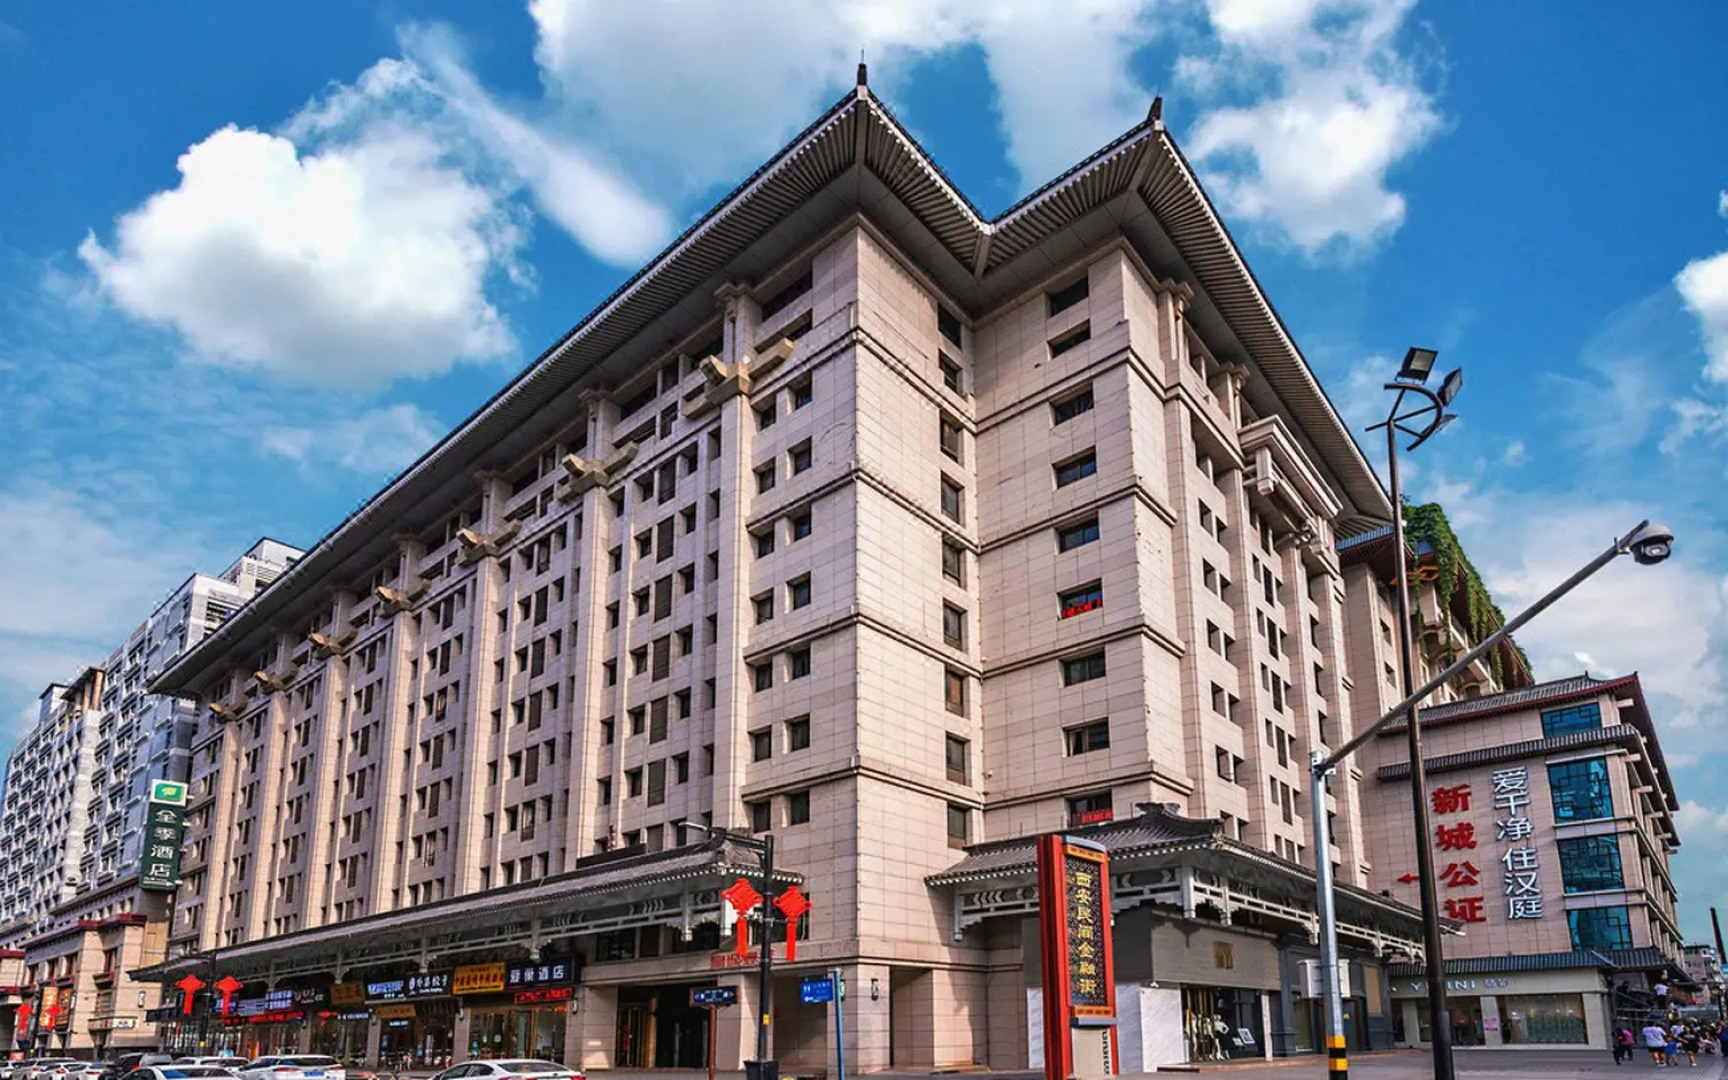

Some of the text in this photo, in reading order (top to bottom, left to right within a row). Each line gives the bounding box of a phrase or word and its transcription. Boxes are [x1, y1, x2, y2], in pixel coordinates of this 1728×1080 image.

[149, 810, 177, 877] 全季酒店
[1432, 784, 1487, 923] 新城公证
[1075, 871, 1097, 994] 西安民间金融街
